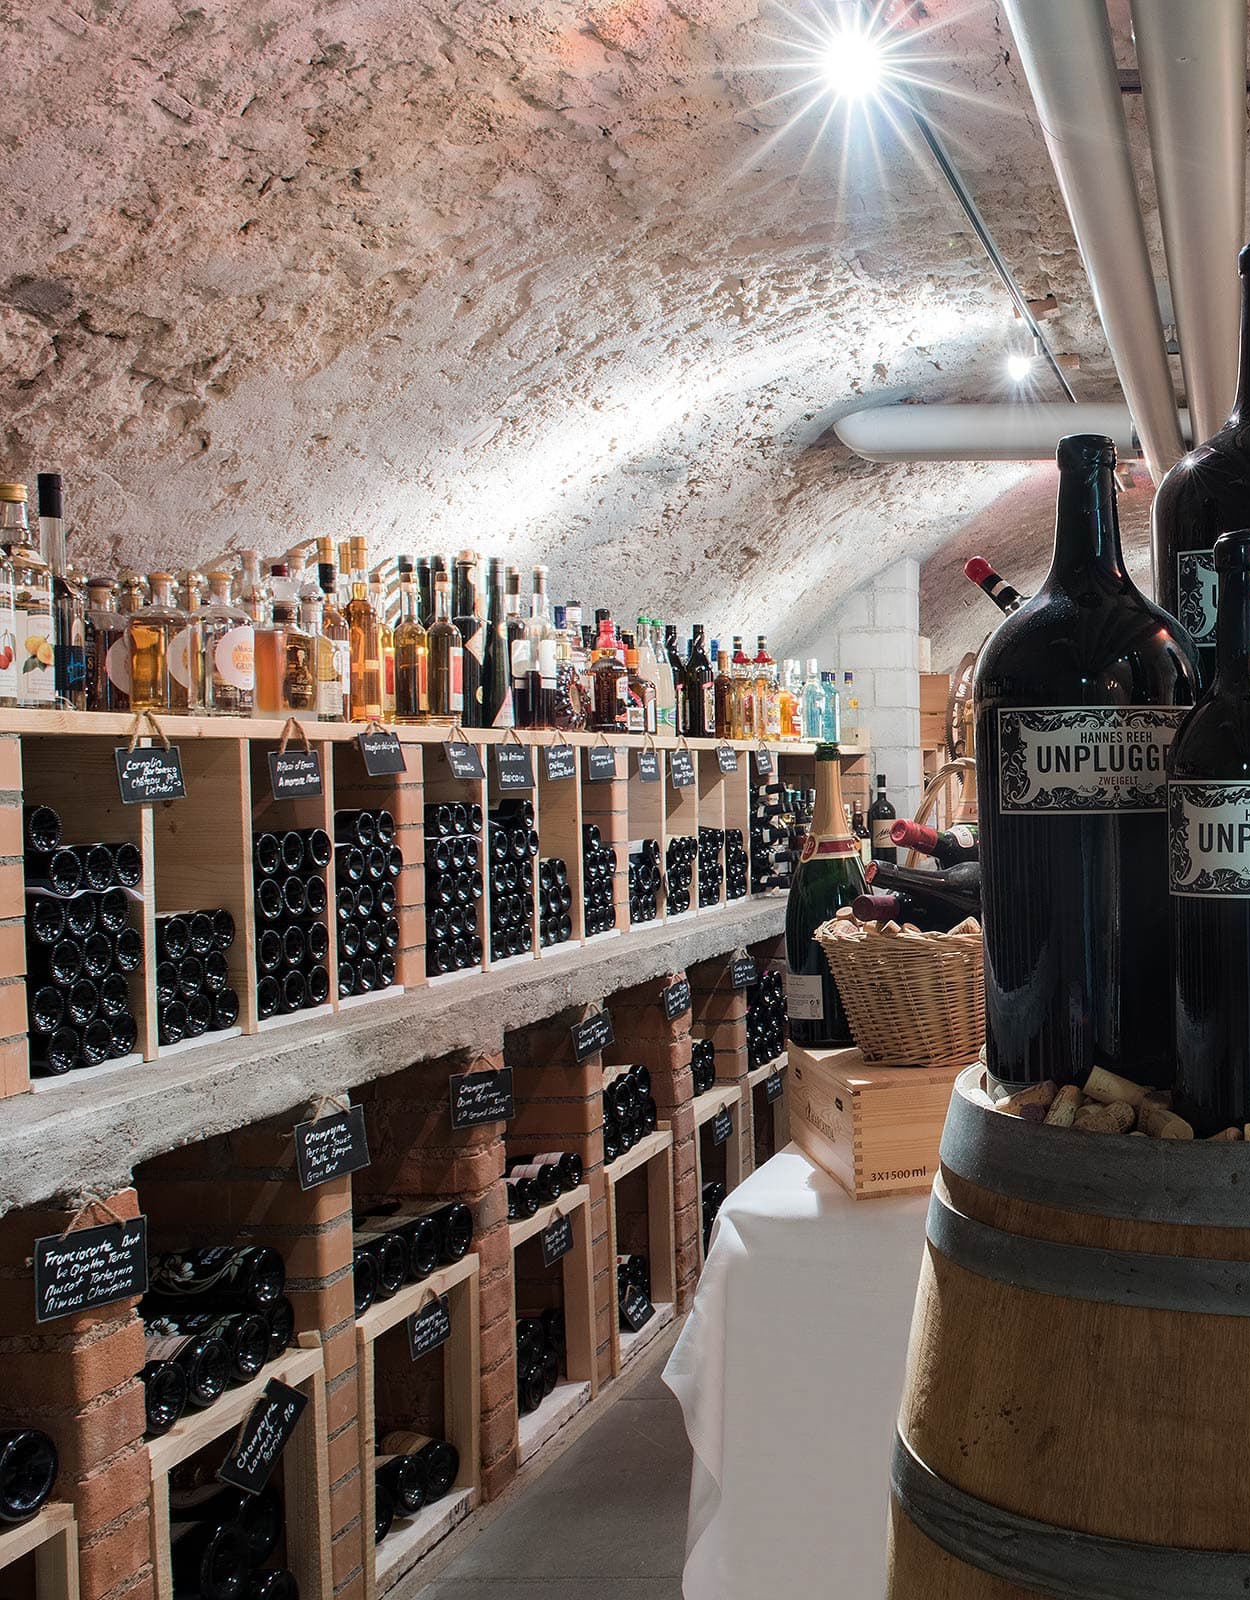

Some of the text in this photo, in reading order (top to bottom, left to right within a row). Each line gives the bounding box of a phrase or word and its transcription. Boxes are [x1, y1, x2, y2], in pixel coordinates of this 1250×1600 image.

[1080, 732, 1152, 743] HANNES REEH
[1099, 776, 1138, 786] ZWEIGELT
[304, 1123, 348, 1145] Champagne
[870, 1165, 927, 1182] 3X1500 ml
[44, 1232, 141, 1267] Franciacorta Brut
[56, 1250, 132, 1279] Le Quattro Terre
[86, 1279, 133, 1300] Champion
[236, 1402, 279, 1469] Champagne
